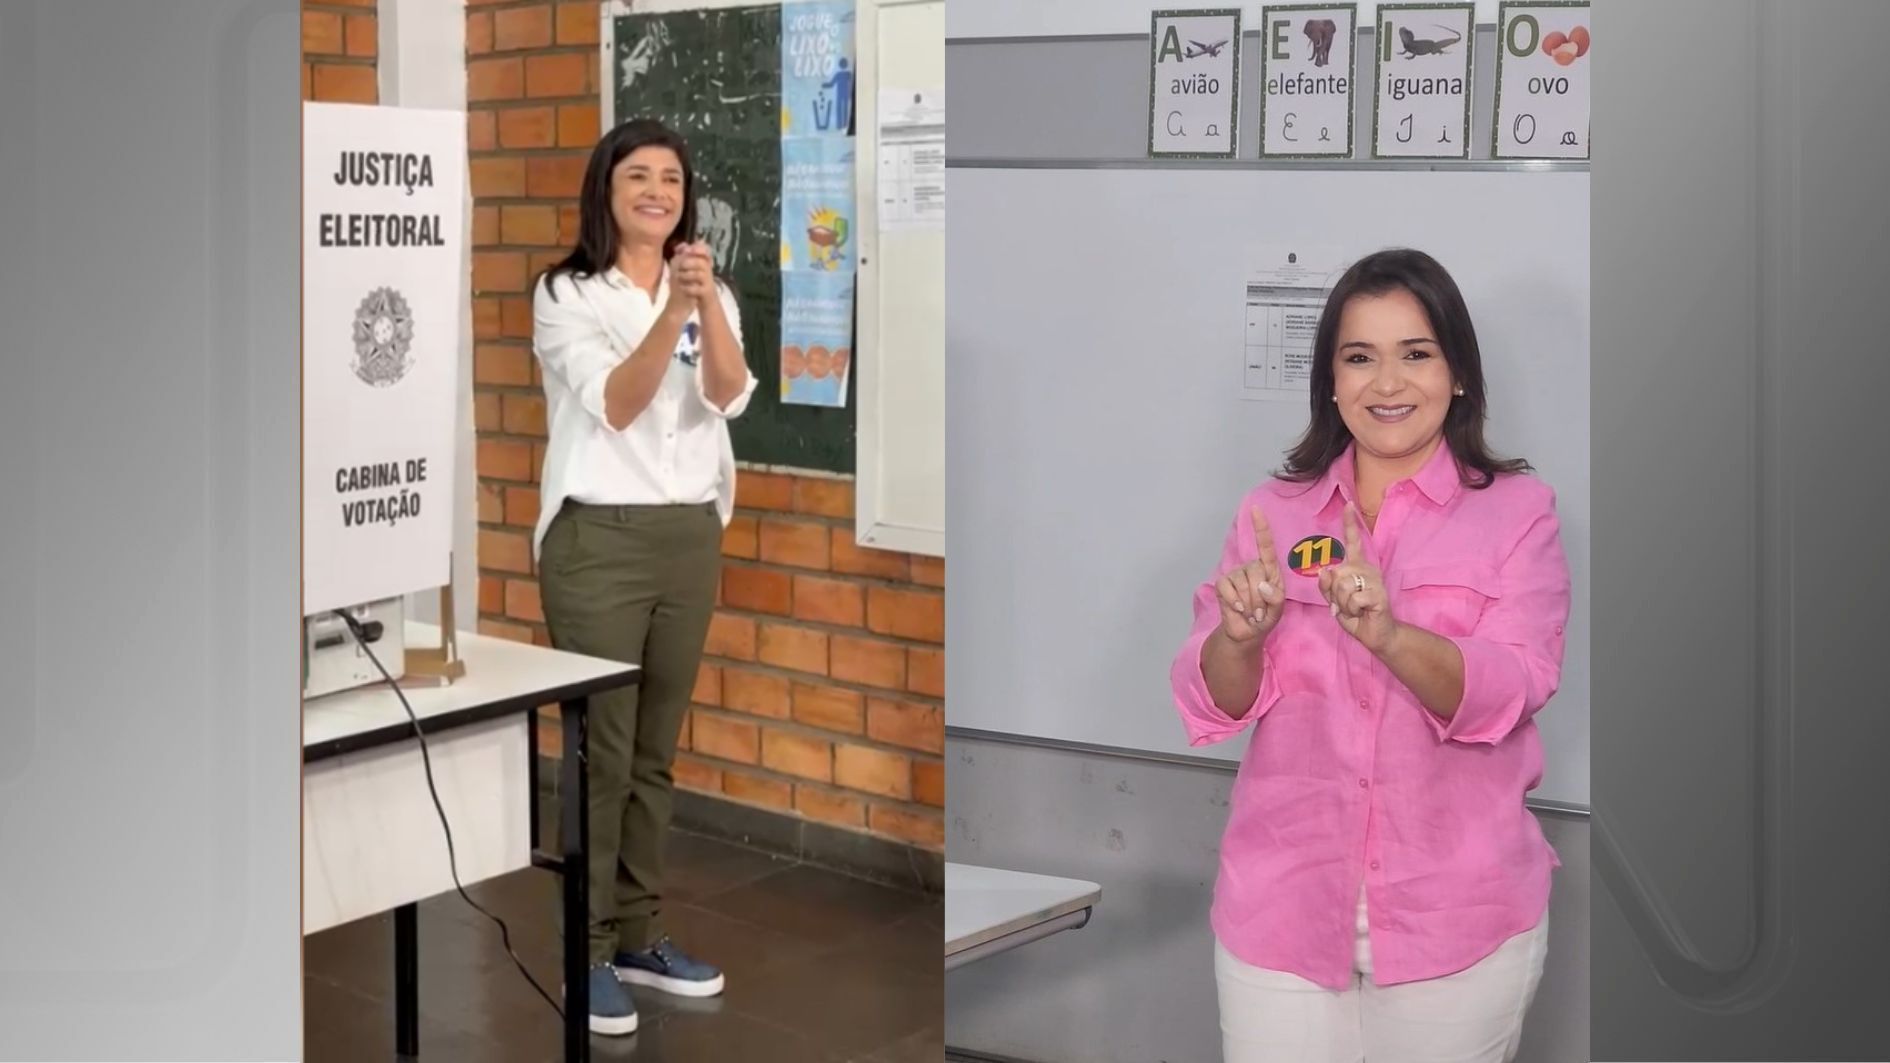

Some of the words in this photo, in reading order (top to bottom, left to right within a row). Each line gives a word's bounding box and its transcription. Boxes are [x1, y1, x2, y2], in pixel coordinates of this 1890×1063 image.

[789, 13, 832, 31] JOGUE
[1506, 14, 1540, 57] O
[790, 33, 830, 56] LIXO
[1158, 25, 1183, 63] A
[1272, 20, 1290, 60] E
[1383, 21, 1392, 62] I
[794, 54, 834, 77] LIXO
[1171, 73, 1219, 95] avião
[1268, 72, 1347, 95] elefante
[1387, 73, 1463, 100] iguana
[1528, 77, 1569, 95] ovo
[1205, 123, 1220, 137] a
[1282, 112, 1298, 142] E
[1317, 126, 1331, 142] e
[1437, 125, 1451, 143] i
[1513, 113, 1536, 144] O
[334, 151, 434, 197] JUSTIÇA
[319, 213, 445, 248] ELEITORAL
[336, 461, 401, 493] CABINA
[405, 457, 427, 483] DE
[342, 488, 421, 528] VOTAÇÃO
[1293, 537, 1332, 570] 11
